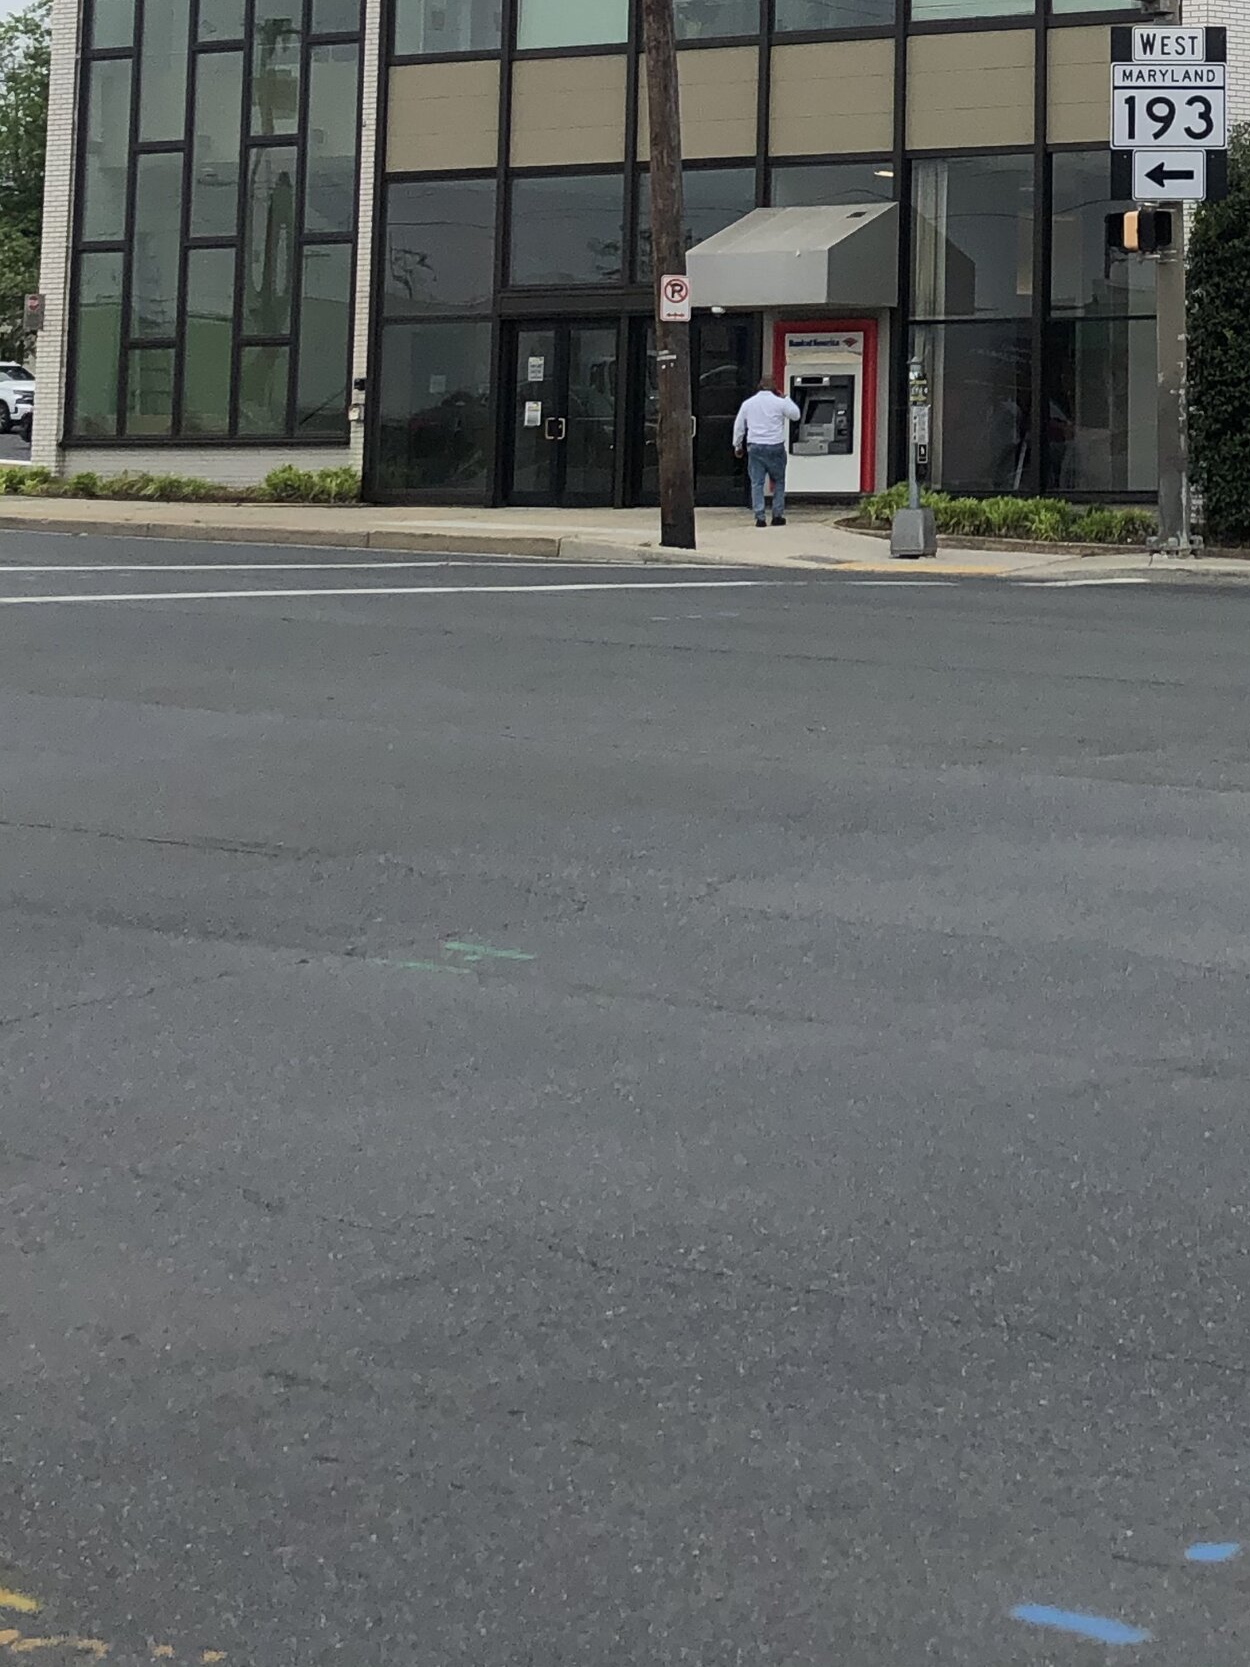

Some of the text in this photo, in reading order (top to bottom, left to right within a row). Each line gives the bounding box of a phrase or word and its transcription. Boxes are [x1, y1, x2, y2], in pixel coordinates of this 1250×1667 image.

[1140, 33, 1198, 56] WEST
[1122, 69, 1216, 83] MARYLAND
[1124, 95, 1214, 140] 193
